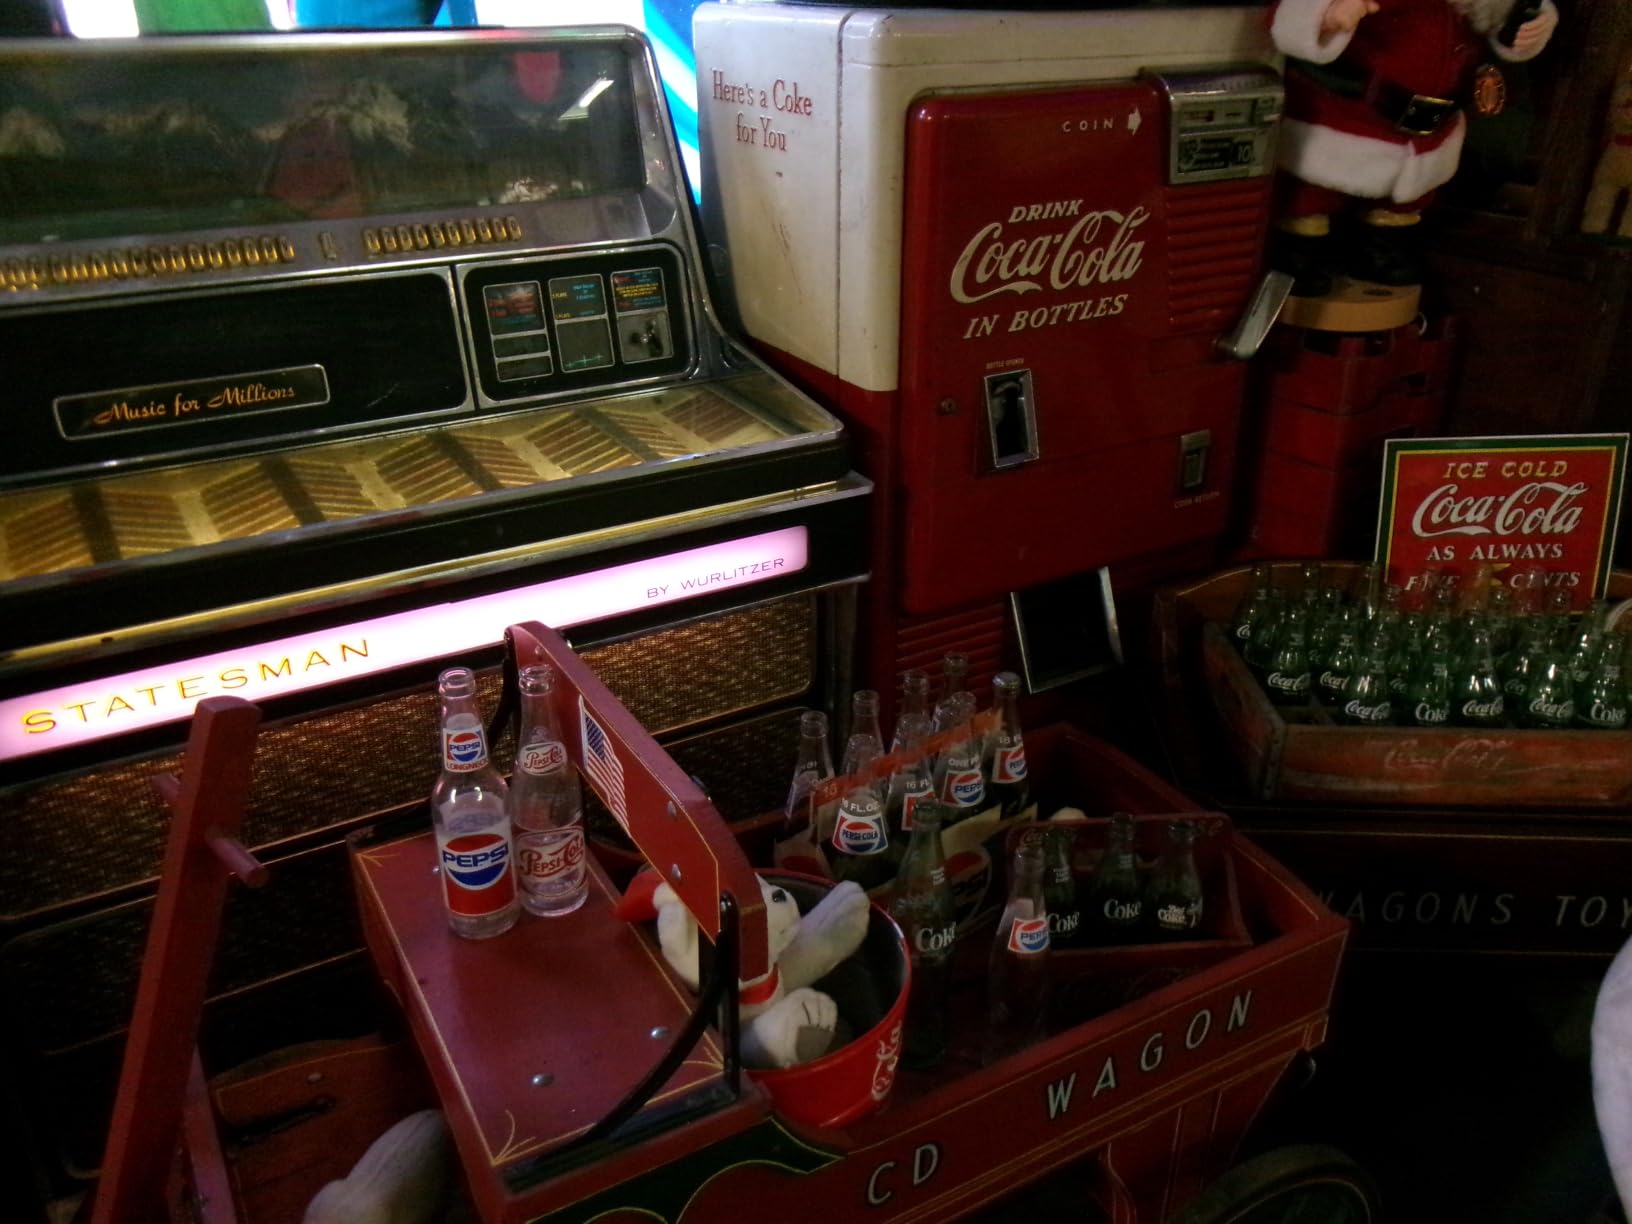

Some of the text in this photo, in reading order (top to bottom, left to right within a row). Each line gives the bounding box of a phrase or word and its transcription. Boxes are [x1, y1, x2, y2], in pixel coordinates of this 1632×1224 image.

[712, 69, 812, 116] Here's a Coke
[736, 112, 787, 152] for You
[1061, 117, 1115, 133] COIN
[1008, 199, 1084, 224] DRINK
[950, 205, 1151, 304] Coca-Cola
[962, 293, 1129, 339] IN BOTTLES
[94, 383, 295, 424] Music for Millions
[1442, 460, 1569, 479] ICE COLD
[1411, 481, 1590, 538] Coca-Cola
[1426, 543, 1564, 561] AS ALWAYS
[647, 557, 786, 599] BY WURLITZER
[21, 639, 370, 734] STATESMAN
[449, 741, 481, 752] PEPSI
[443, 843, 509, 867] PEPSI
[1104, 898, 1142, 920] Coke
[1047, 990, 1252, 1120] WAGON
[867, 1143, 940, 1205] CD
